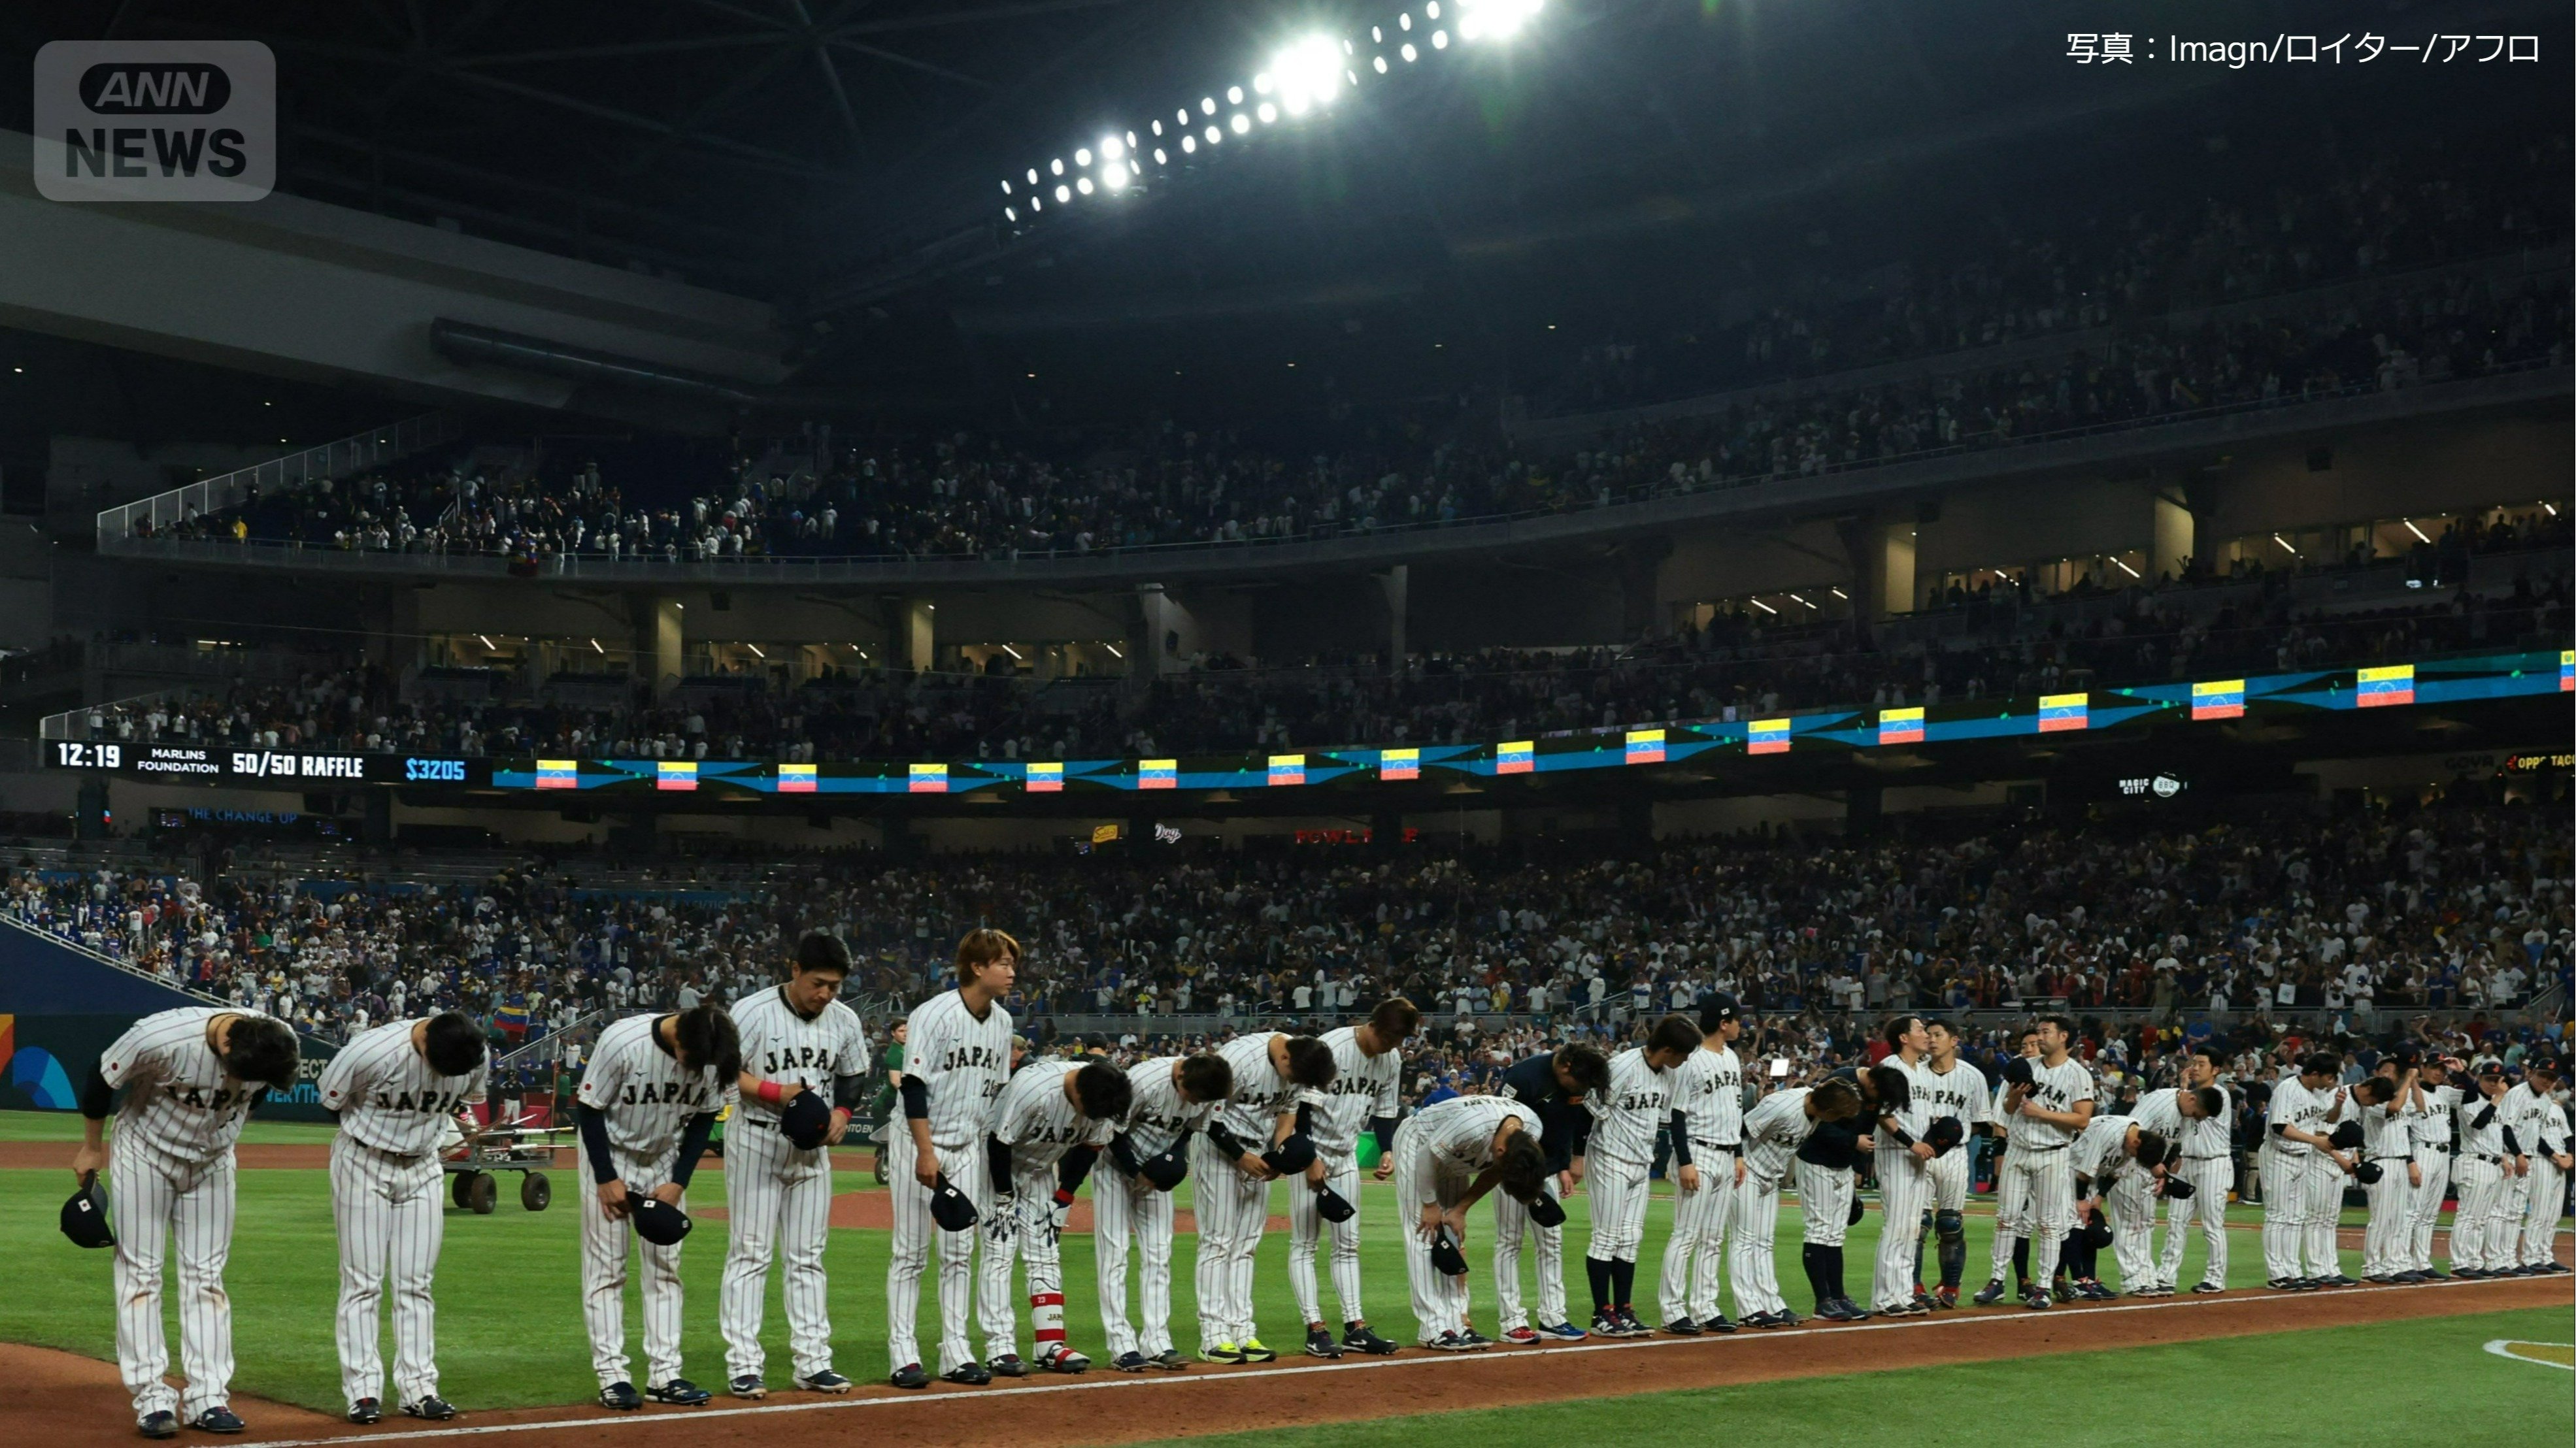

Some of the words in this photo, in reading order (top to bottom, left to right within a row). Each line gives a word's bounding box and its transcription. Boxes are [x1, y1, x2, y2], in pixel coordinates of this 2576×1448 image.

[58, 742, 120, 768] 12:19
[152, 748, 206, 760] MARLINS
[137, 761, 220, 774] FOUNDATION
[232, 751, 295, 777] 50/50
[301, 755, 363, 778] RAFFLE
[406, 758, 465, 780] $3205
[2118, 778, 2150, 788] MAGIC
[2123, 786, 2145, 795] CITY
[188, 807, 212, 820] THE
[216, 808, 273, 823] CHANGE
[278, 812, 297, 825] UP
